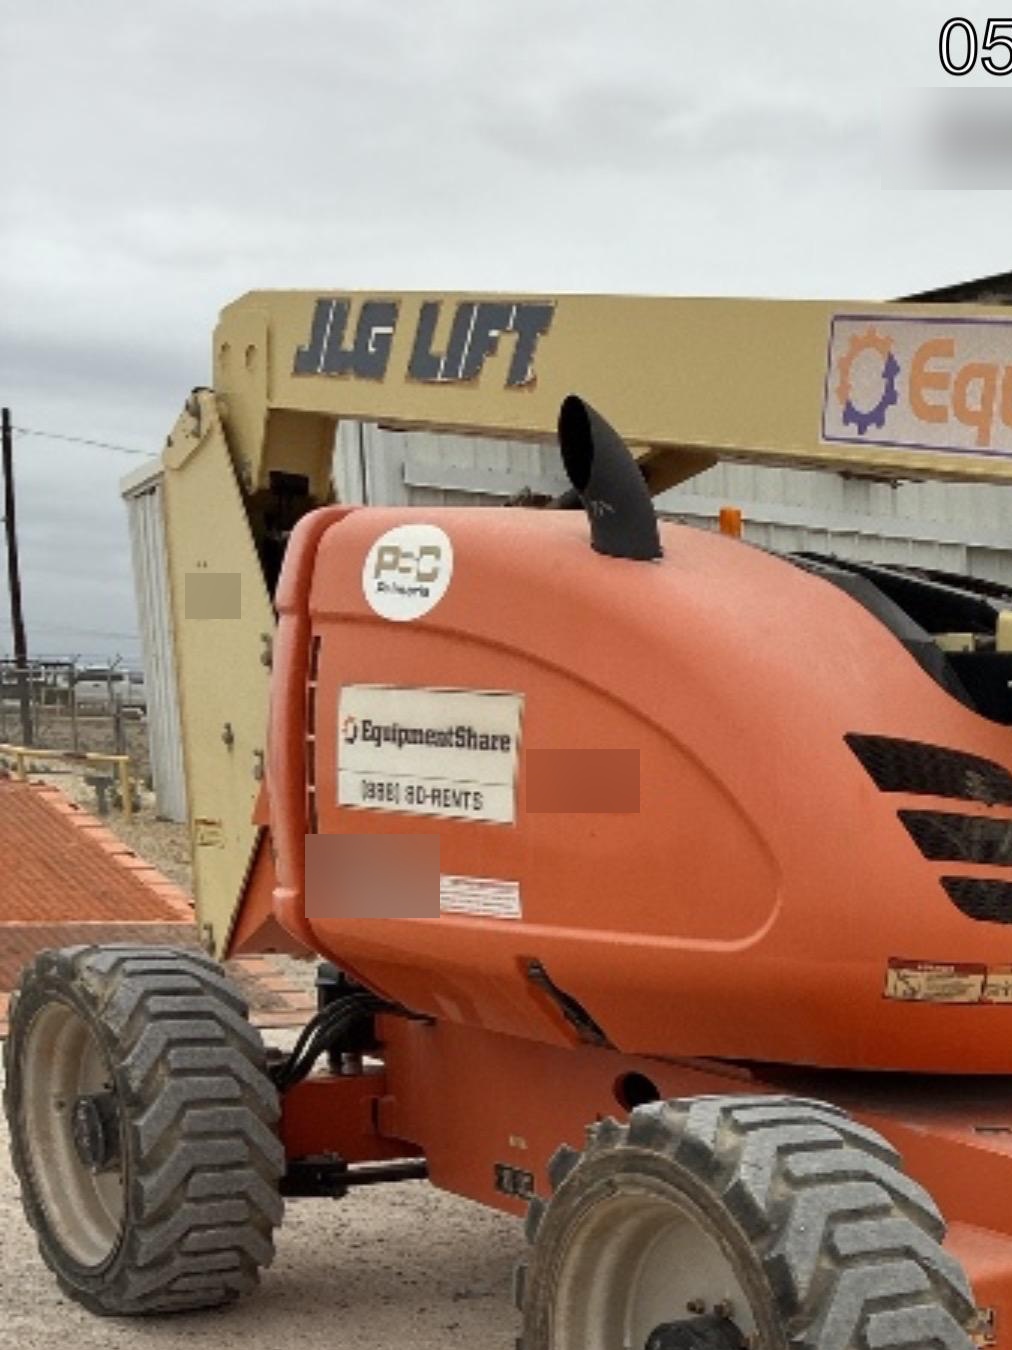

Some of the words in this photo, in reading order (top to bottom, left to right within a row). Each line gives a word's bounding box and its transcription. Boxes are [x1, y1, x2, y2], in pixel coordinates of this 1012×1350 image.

[293, 297, 400, 381] JLG
[406, 299, 556, 391] LIFT
[361, 719, 511, 753] EquipmentShare
